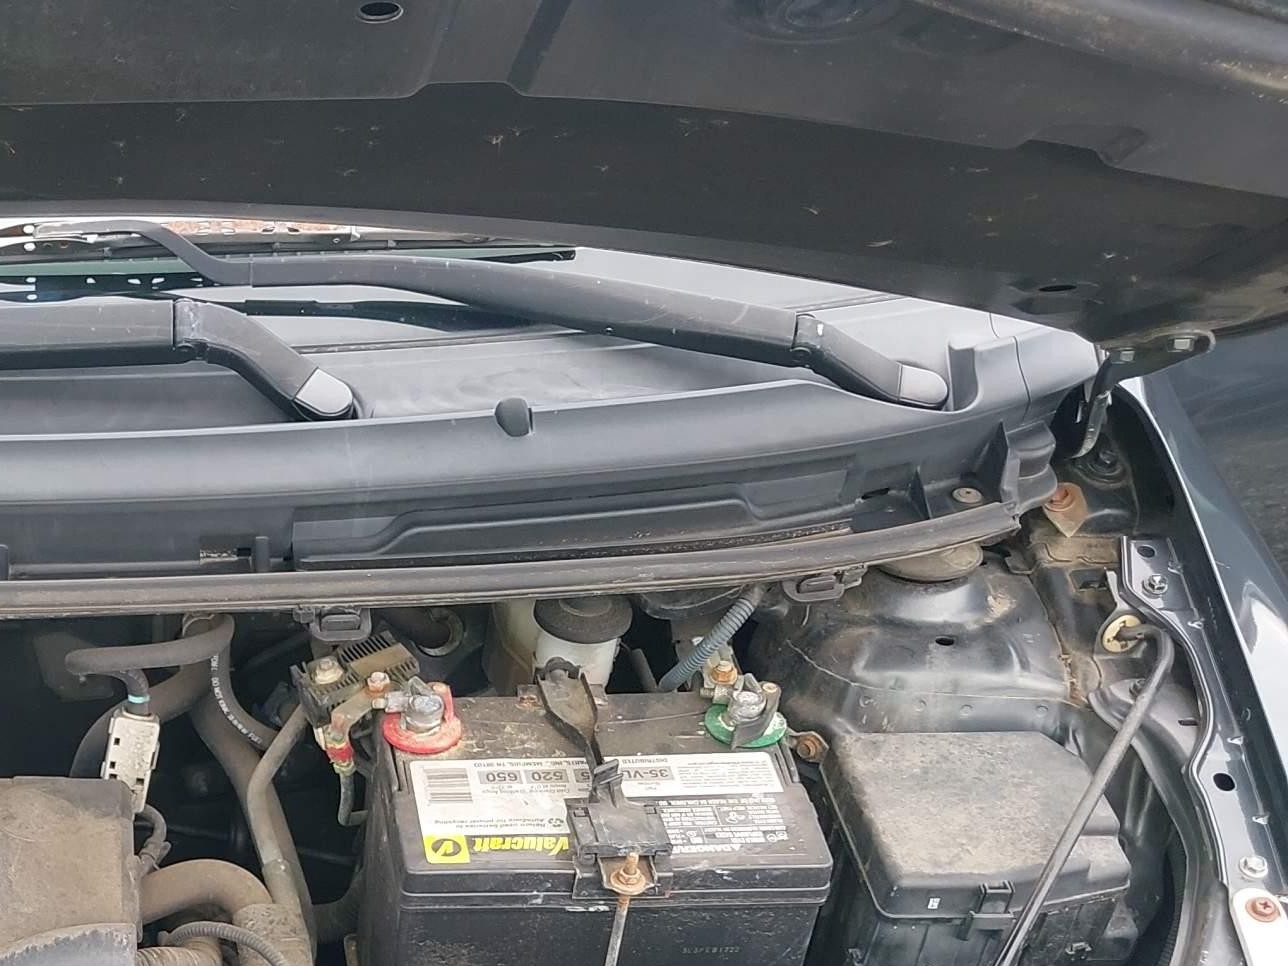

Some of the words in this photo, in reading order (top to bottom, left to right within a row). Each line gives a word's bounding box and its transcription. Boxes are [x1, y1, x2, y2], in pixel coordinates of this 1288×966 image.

[485, 772, 518, 783] 650
[531, 771, 564, 781] 520
[472, 836, 569, 856] Valucraft
